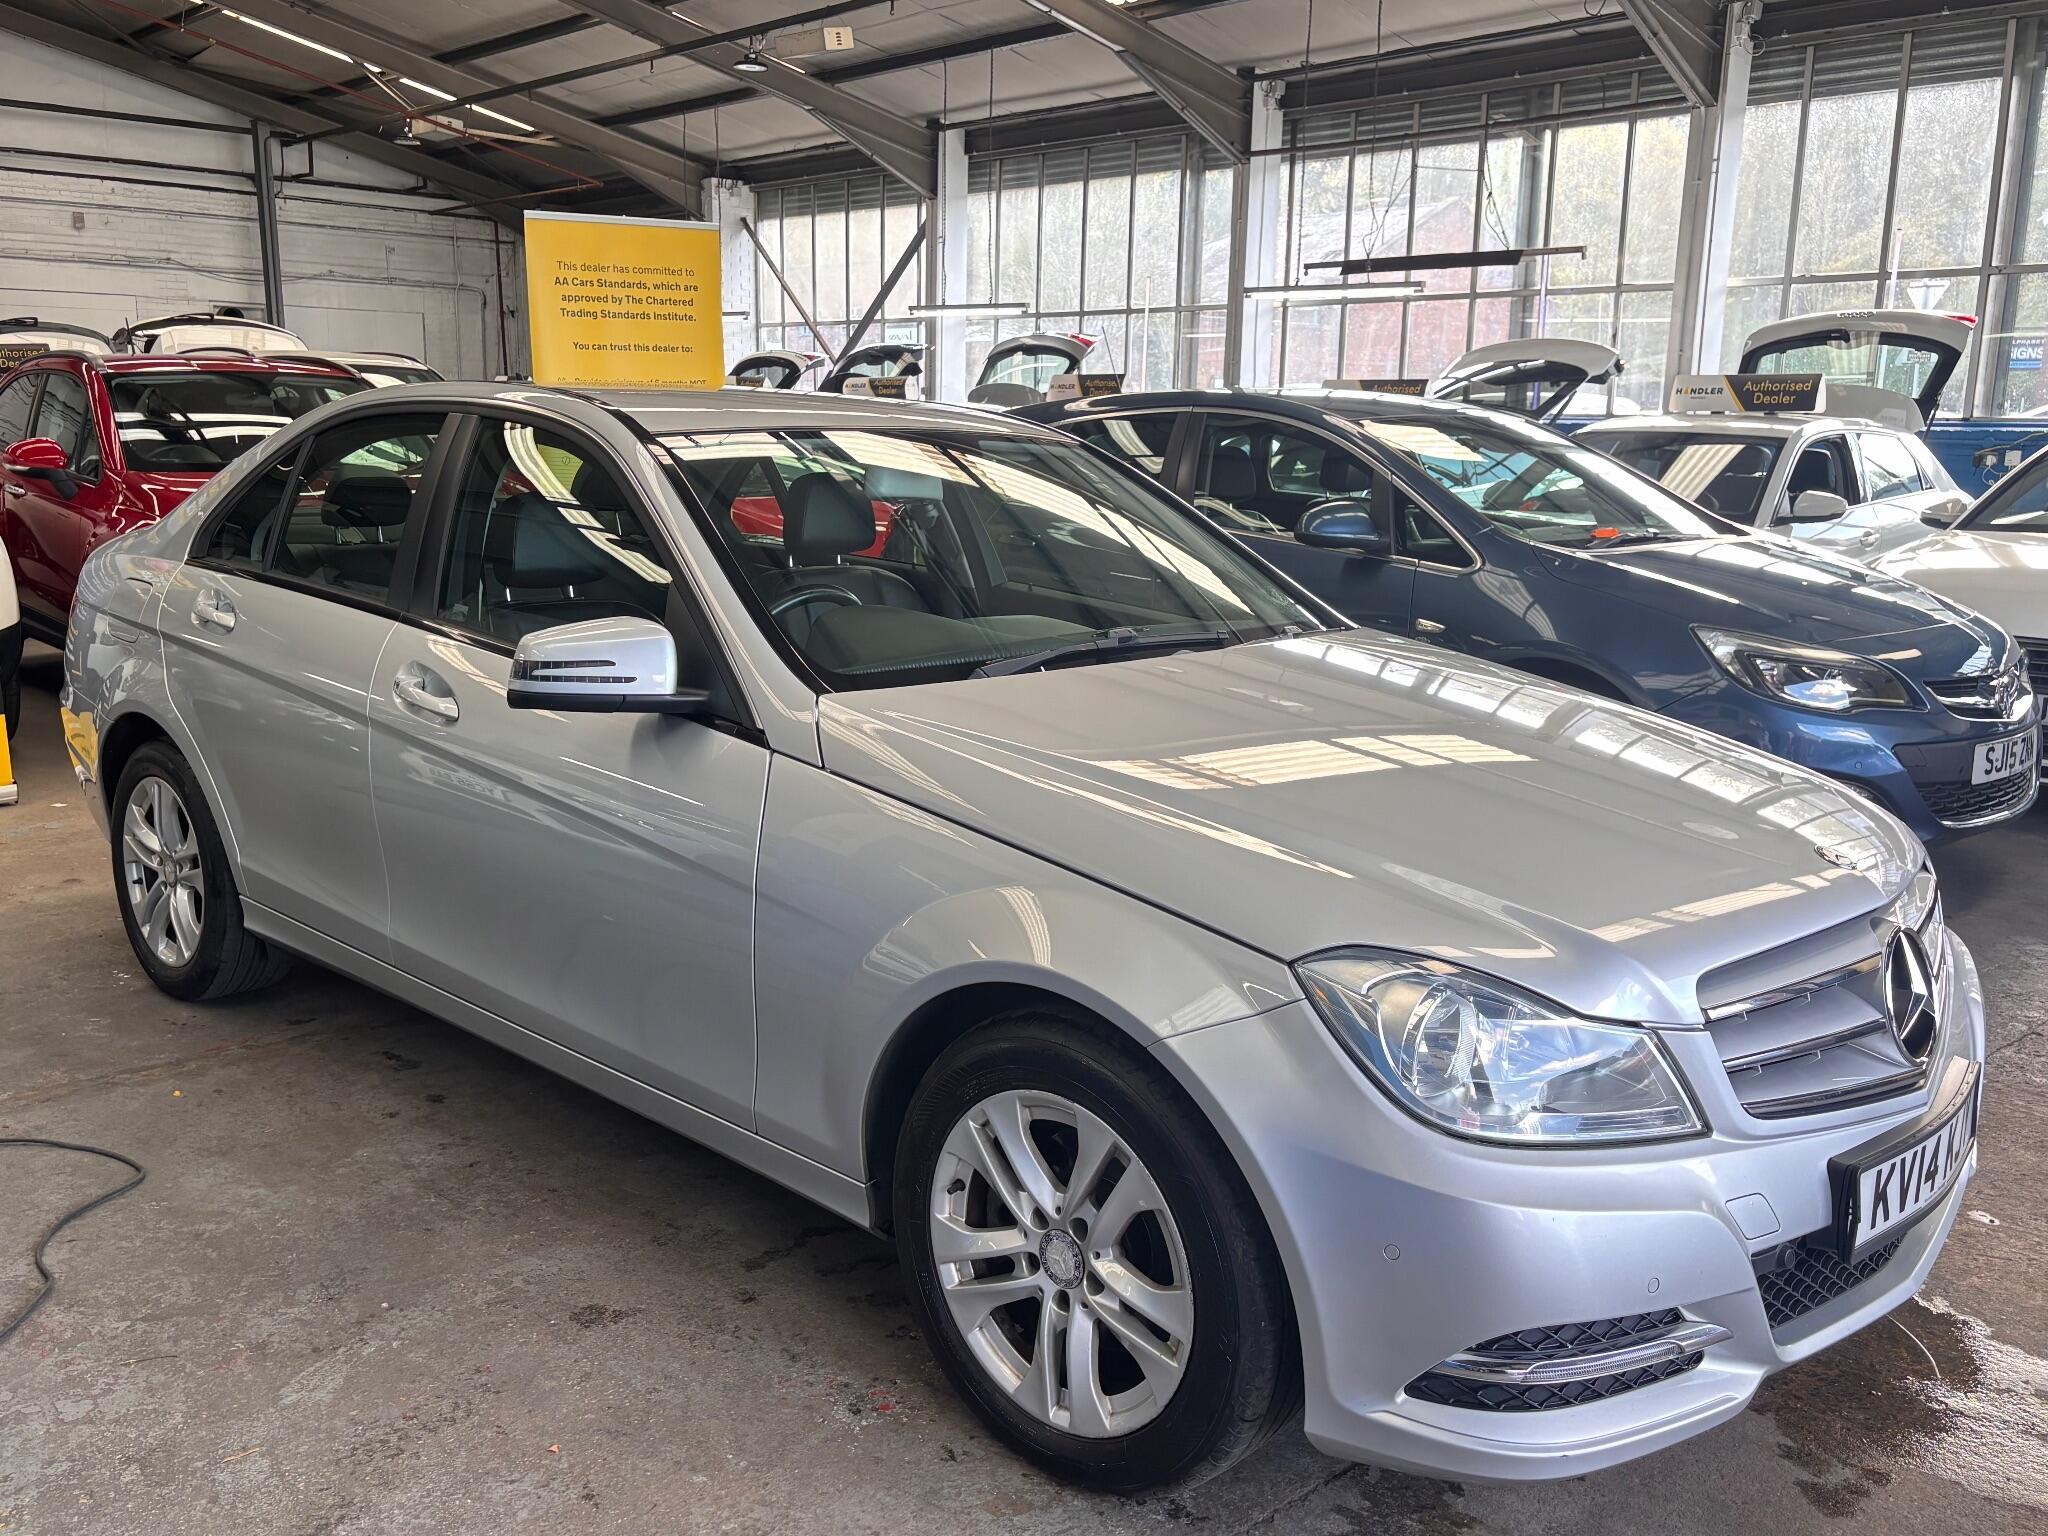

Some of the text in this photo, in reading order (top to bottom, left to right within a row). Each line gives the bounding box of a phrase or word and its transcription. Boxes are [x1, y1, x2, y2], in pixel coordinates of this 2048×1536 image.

[557, 261, 695, 277] This dealer has committed to
[554, 276, 699, 292] AA Cars Standards, which are
[561, 294, 694, 307] approved by The Chartered
[560, 307, 697, 322] Trading Standards Institute.
[573, 341, 693, 353] You can trust this dealer to:
[1743, 378, 1813, 392] Authorised
[1753, 392, 1796, 404] Dealer
[1984, 740, 2018, 776] SJ15
[1871, 1133, 1942, 1230] KV14
